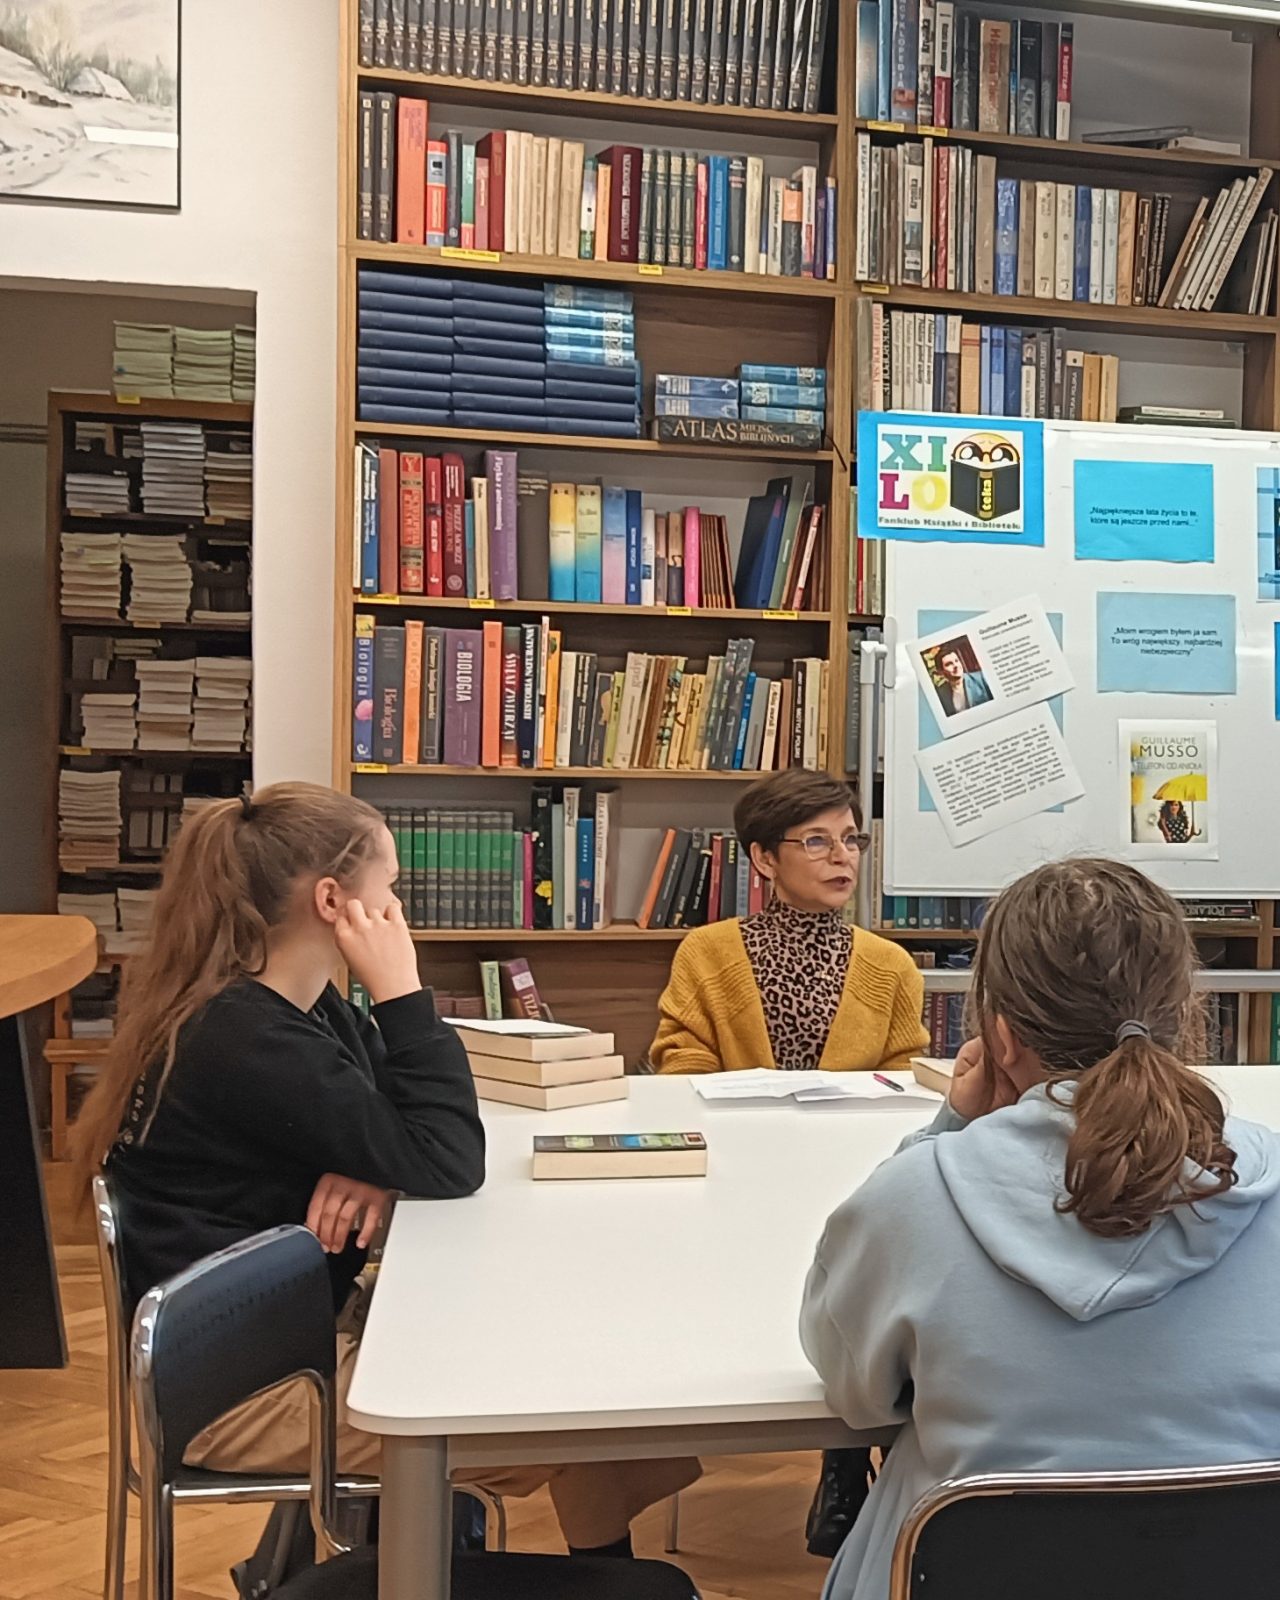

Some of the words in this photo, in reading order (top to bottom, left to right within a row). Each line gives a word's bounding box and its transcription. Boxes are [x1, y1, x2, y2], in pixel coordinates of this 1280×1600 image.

[873, 346, 881, 384] POLSKI
[673, 419, 738, 440] ATLAS
[740, 423, 773, 433] MIEJSC
[740, 432, 795, 443] BIBLIJNYCH
[881, 433, 947, 472] XI
[493, 456, 503, 482] Fizyka
[880, 473, 947, 512] LO
[982, 479, 992, 510] teka
[454, 504, 462, 531] PRZEZ
[879, 516, 921, 526] Fanklub
[923, 518, 962, 528] Książki
[1146, 508, 1159, 516] lata
[1161, 508, 1179, 517] życia
[454, 533, 463, 565] MORZE
[1122, 638, 1140, 646] wróg
[1184, 639, 1223, 647] najbardziej
[1170, 628, 1191, 637] byłem
[1193, 629, 1200, 637] ja
[356, 638, 371, 696] Biologia
[525, 628, 535, 677] NATURALNA
[456, 652, 473, 702] BIOLOGIA
[504, 653, 519, 685] ŚWIAT
[381, 688, 398, 739] Biologia
[523, 678, 533, 720] HISTORIA
[501, 688, 516, 740] ZWIERZĄT
[1139, 745, 1199, 758] MUSSO
[1141, 736, 1196, 745] GUILLAUME
[1136, 762, 1166, 770] TELEFON
[1166, 762, 1177, 770] OD
[1178, 762, 1202, 770] ANIOŁA
